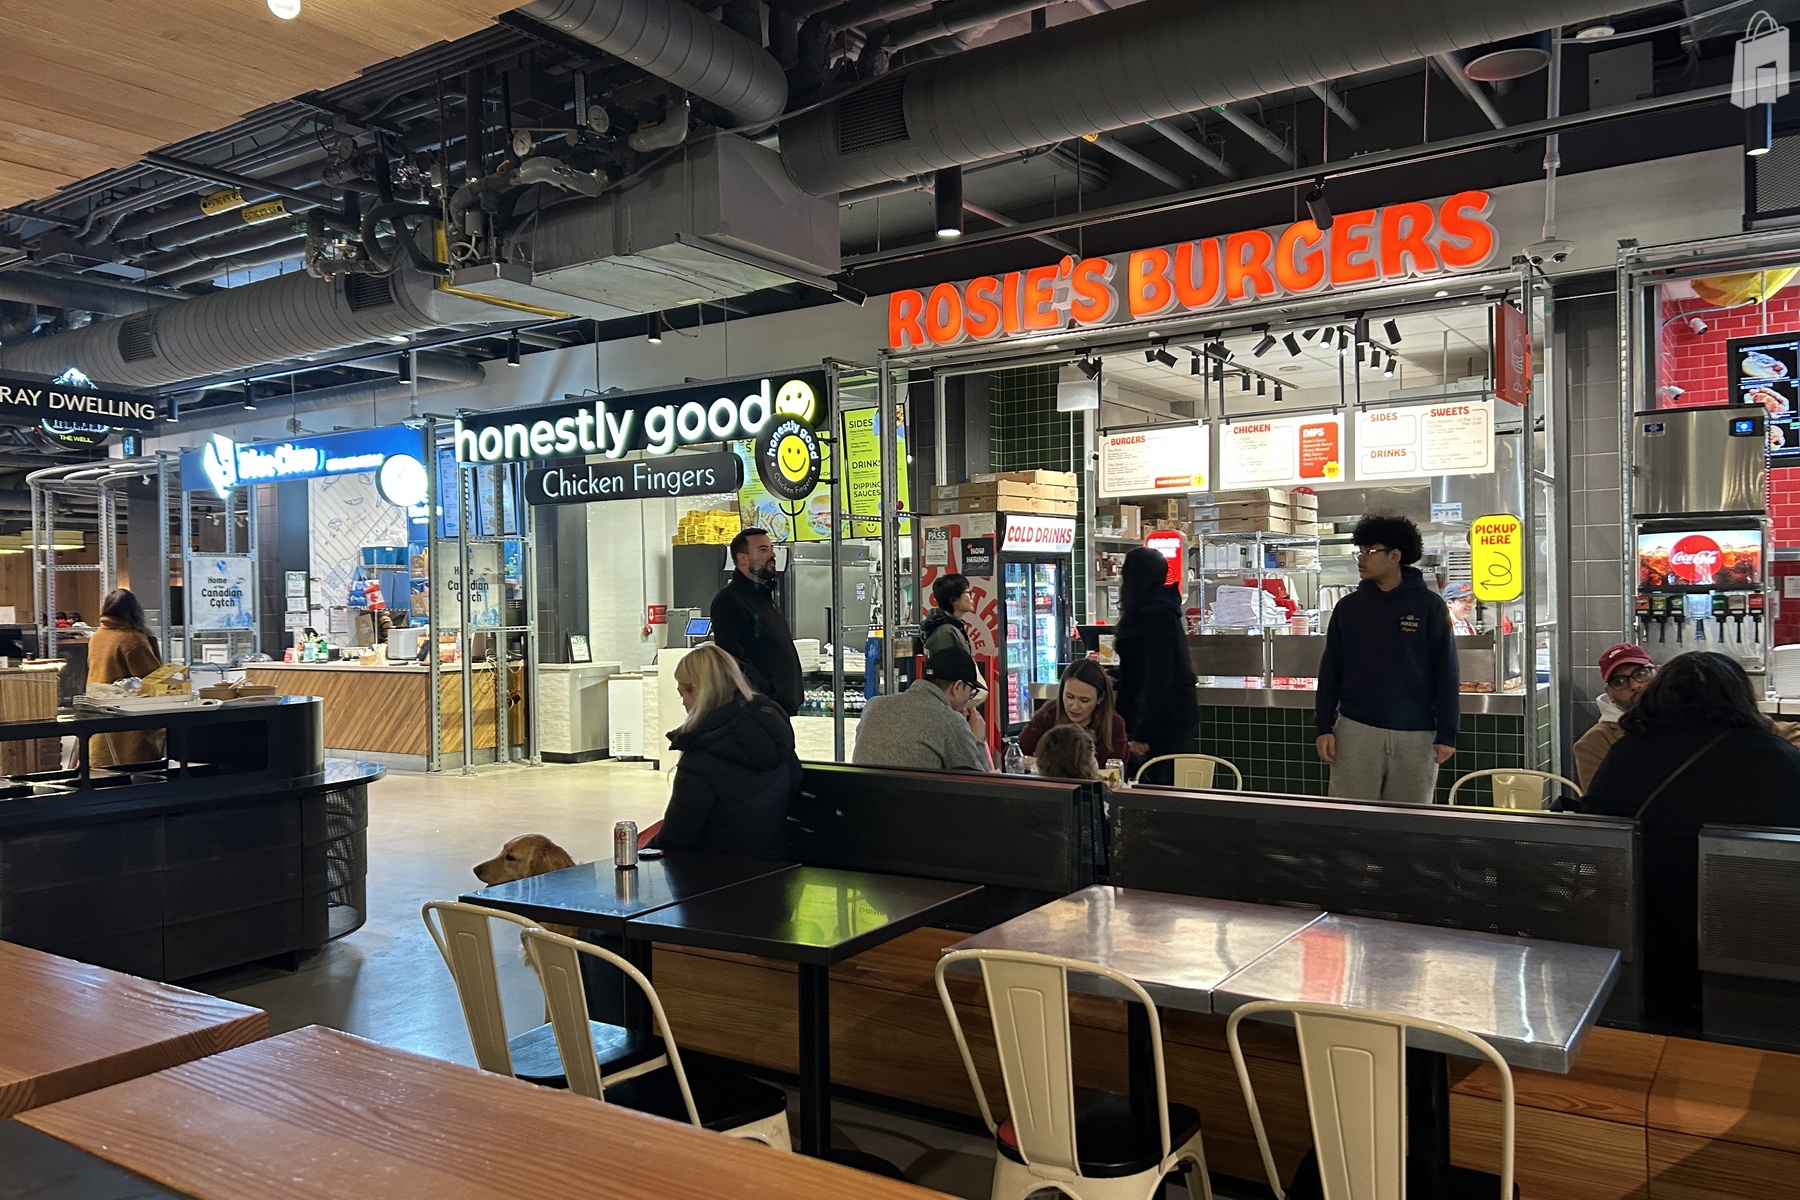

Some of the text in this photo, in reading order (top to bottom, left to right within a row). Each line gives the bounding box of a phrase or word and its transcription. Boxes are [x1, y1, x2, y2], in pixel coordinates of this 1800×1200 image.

[888, 191, 1492, 350] ROSIE'S BURGERS
[49, 391, 156, 420] DWELLING
[1370, 412, 1398, 423] SIDES
[1430, 406, 1470, 418] SWEETS
[455, 379, 771, 459] honestly good
[849, 418, 874, 429] SIDES
[1233, 423, 1271, 435] CHICKEN
[1302, 427, 1325, 438] DIPS
[59, 434, 93, 444] THE WELL
[767, 420, 800, 457] honestly
[799, 428, 819, 460] good
[1110, 435, 1146, 446] BURGERS
[1370, 448, 1407, 459] DRINKS
[542, 469, 624, 498] Chicken
[633, 462, 716, 496] Fingers
[774, 472, 794, 494] Chicken
[794, 476, 813, 494] Fingers
[1475, 523, 1518, 534] PICKUP
[928, 531, 946, 540] PASS
[1007, 525, 1073, 544] COLD DRINKS
[1481, 535, 1511, 545] HERE
[970, 547, 985, 555] NOW
[454, 566, 474, 575] He
[448, 580, 489, 590] Cadian
[201, 588, 242, 598] Canadian
[456, 591, 482, 602] Cch
[964, 621, 986, 650] THE
